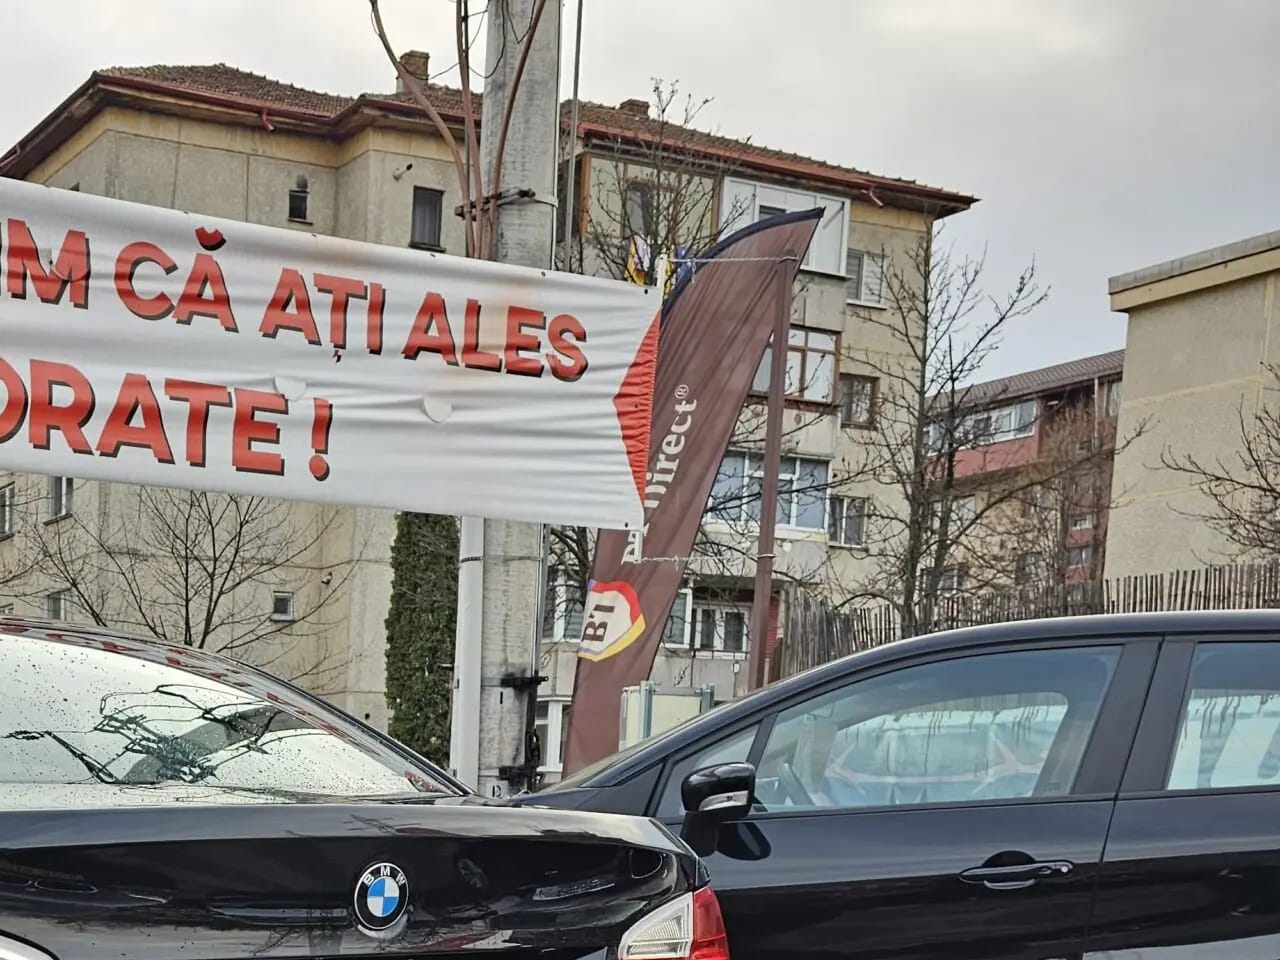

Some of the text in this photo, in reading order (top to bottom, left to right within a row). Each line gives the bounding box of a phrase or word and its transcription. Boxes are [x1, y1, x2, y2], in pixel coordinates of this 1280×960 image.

[114, 226, 238, 334] CĂ
[258, 266, 385, 363] AȚI
[401, 291, 588, 383] ALES
[363, 865, 406, 887] BMW
